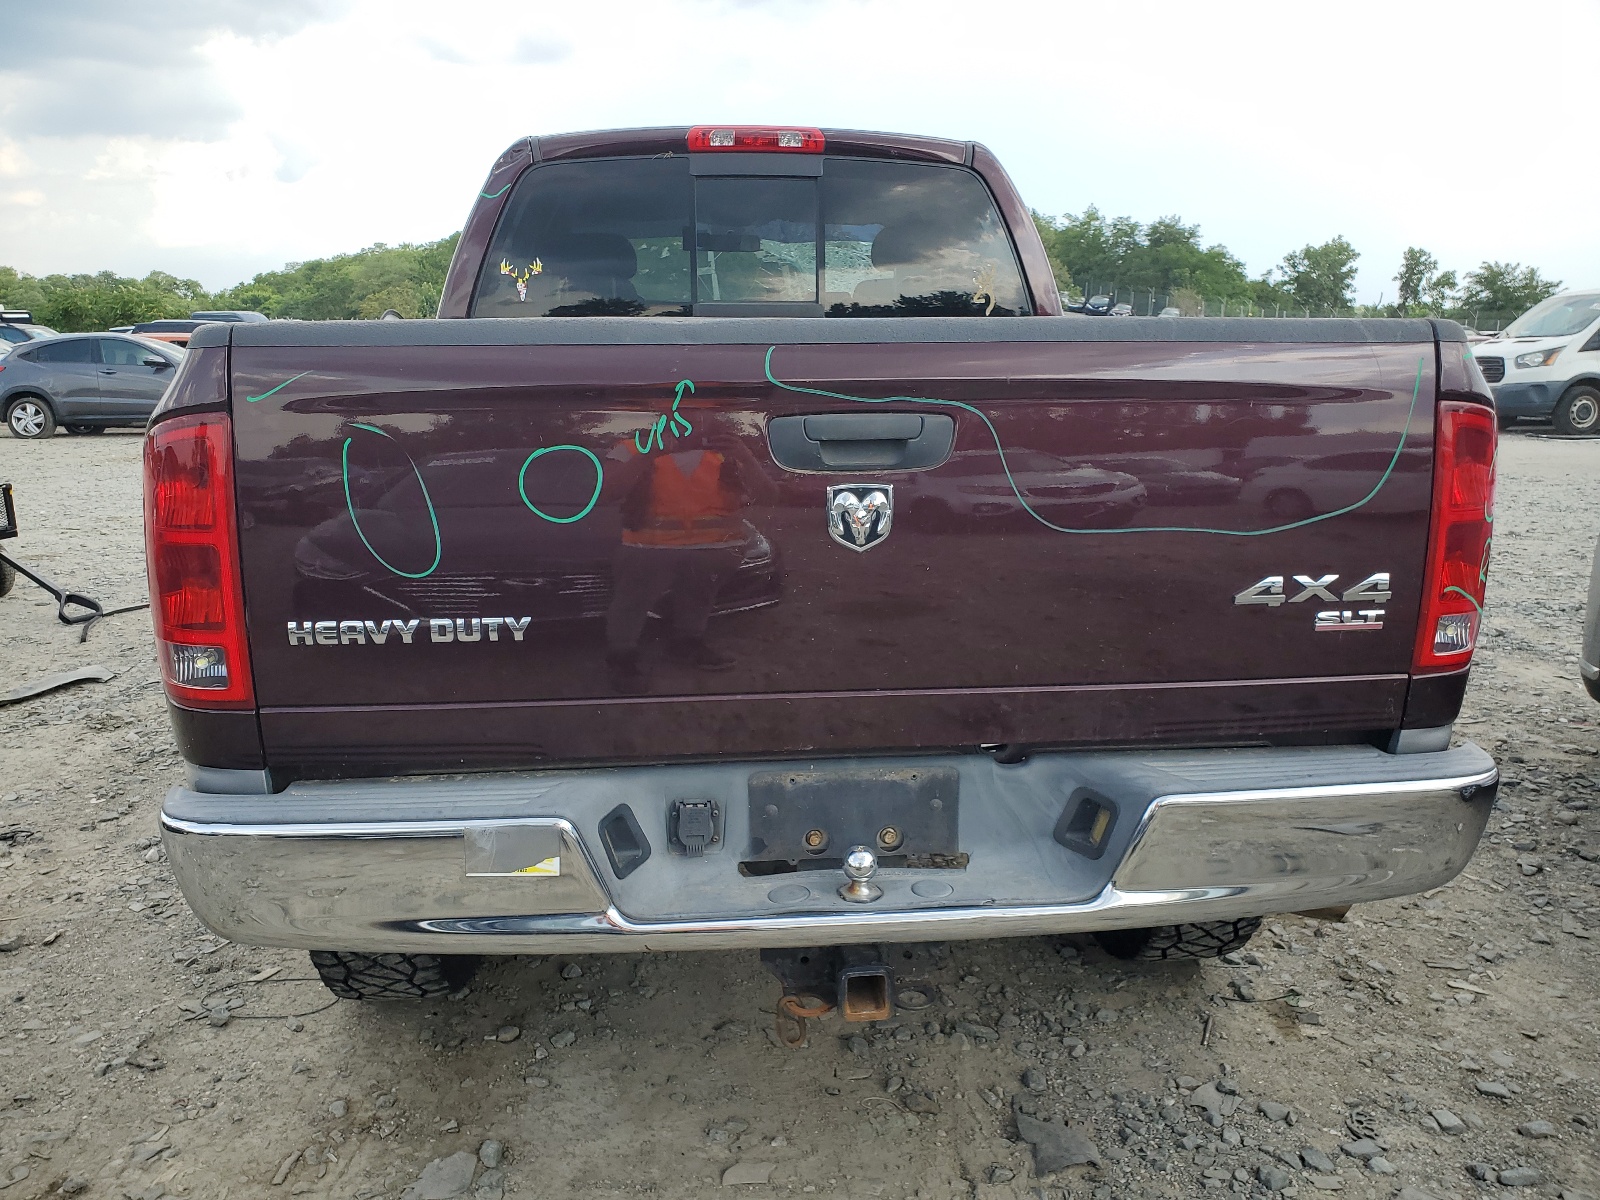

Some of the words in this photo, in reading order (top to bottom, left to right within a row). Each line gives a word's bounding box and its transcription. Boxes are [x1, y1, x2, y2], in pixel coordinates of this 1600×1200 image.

[1315, 609, 1386, 625] SLT
[287, 618, 420, 646] HEAVY
[429, 616, 532, 643] DUTY
